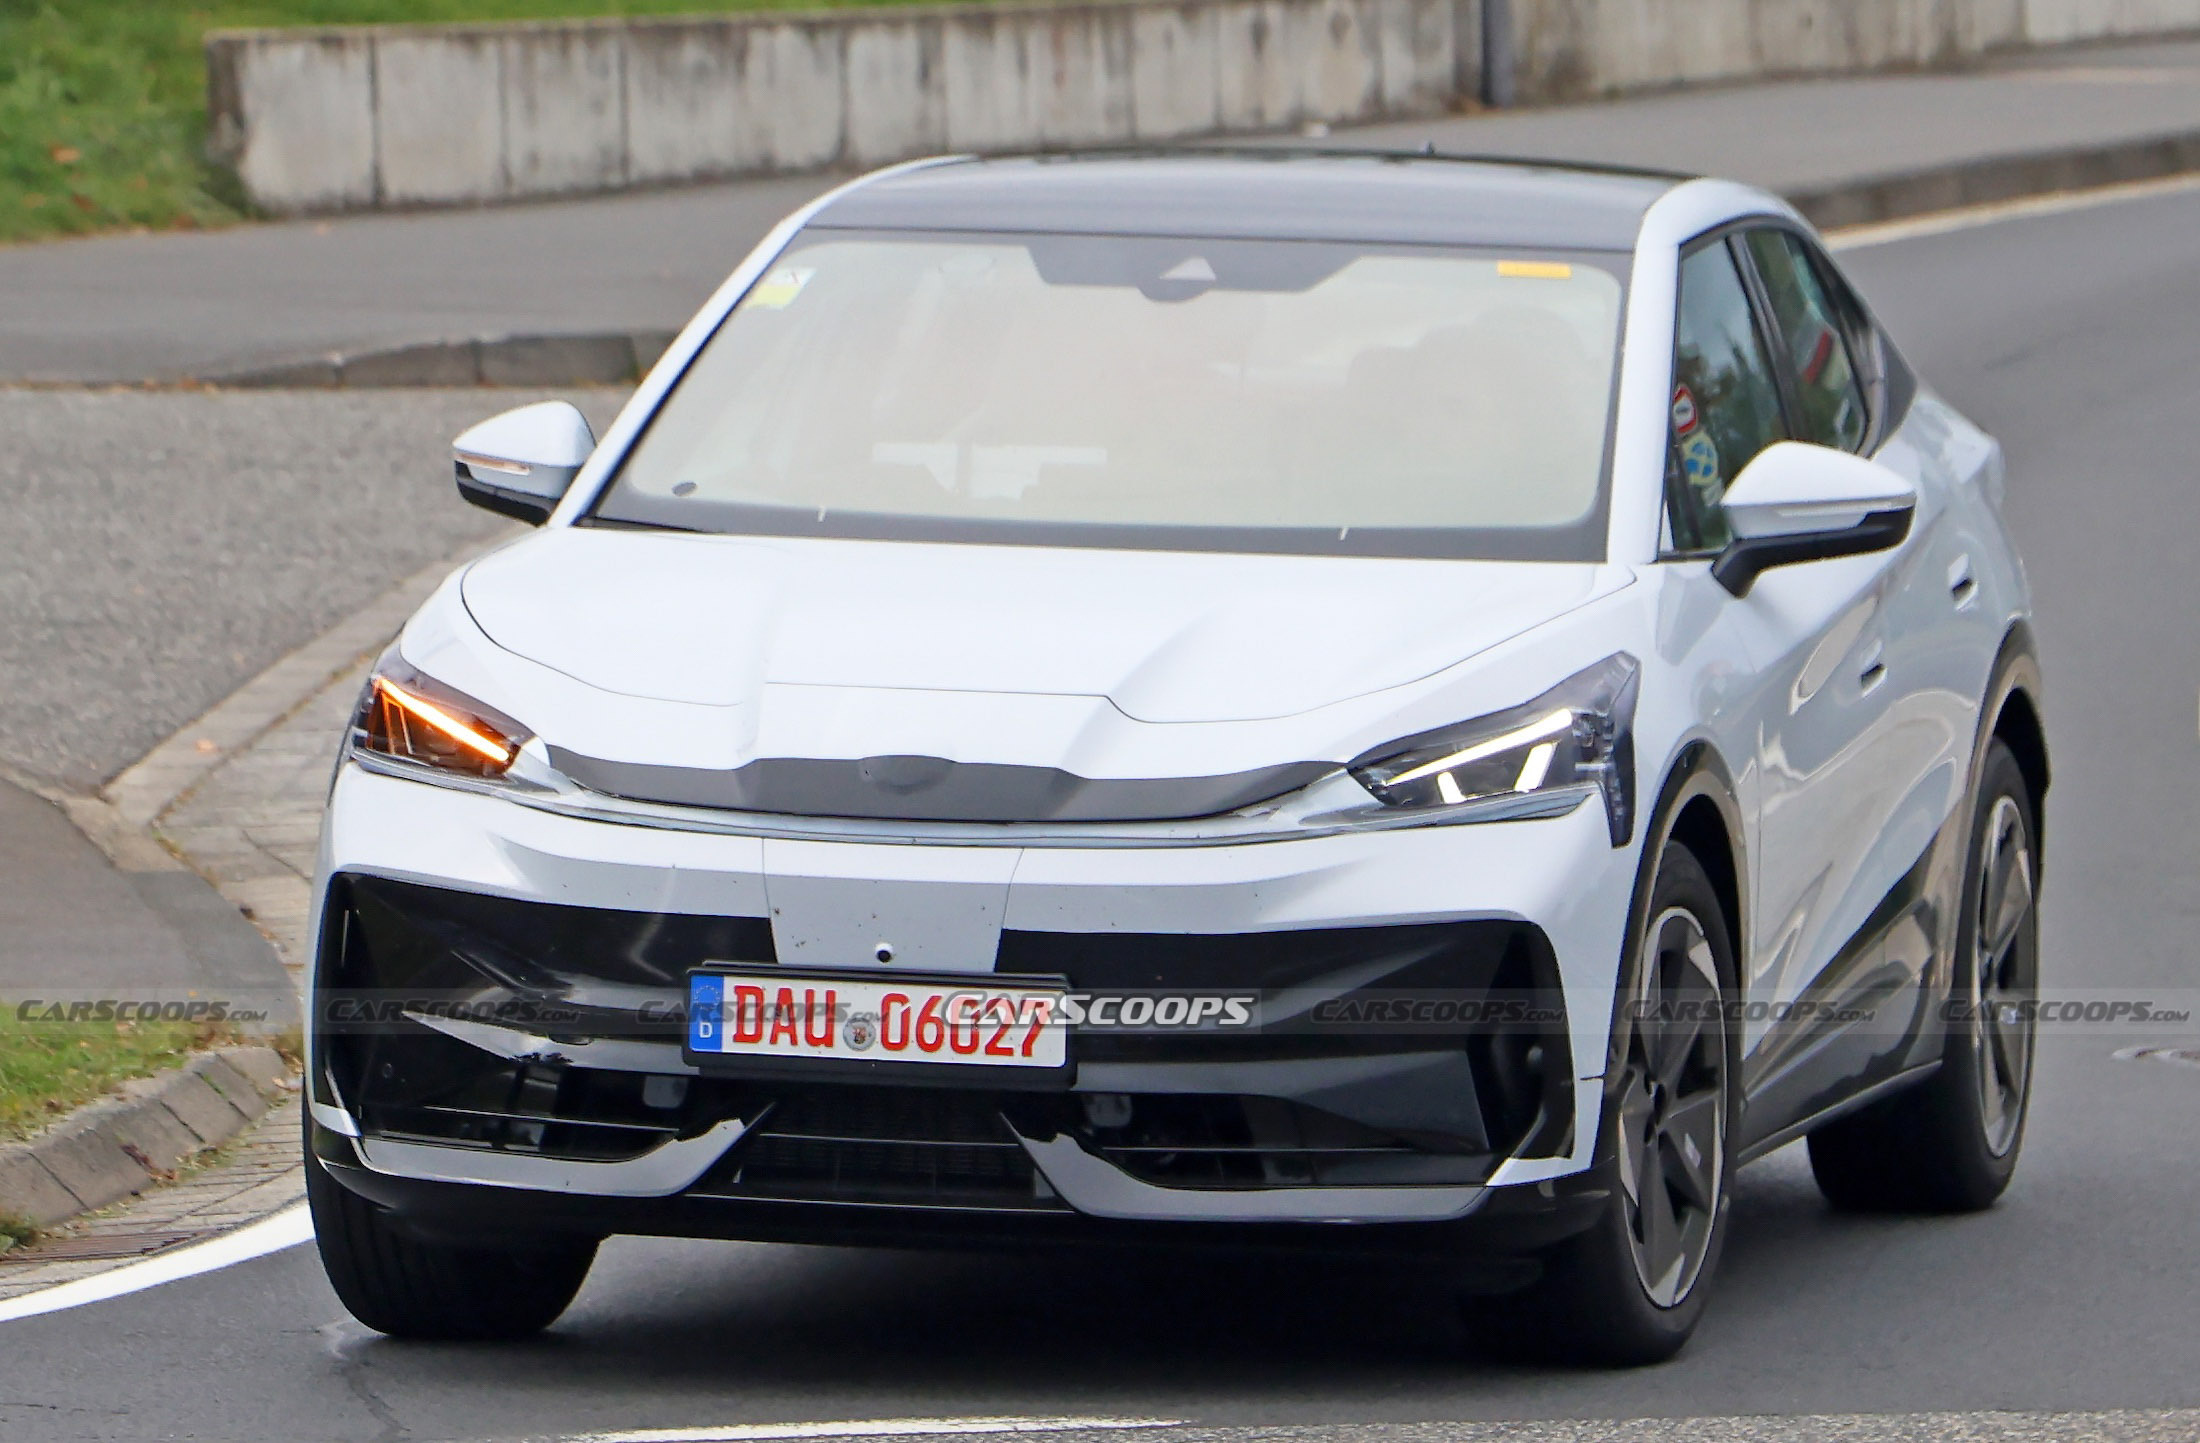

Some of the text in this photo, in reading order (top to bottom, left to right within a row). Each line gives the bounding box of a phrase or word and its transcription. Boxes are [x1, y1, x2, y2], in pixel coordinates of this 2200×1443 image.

[699, 1021, 713, 1038] D
[732, 985, 1051, 1058] DAU 06027
